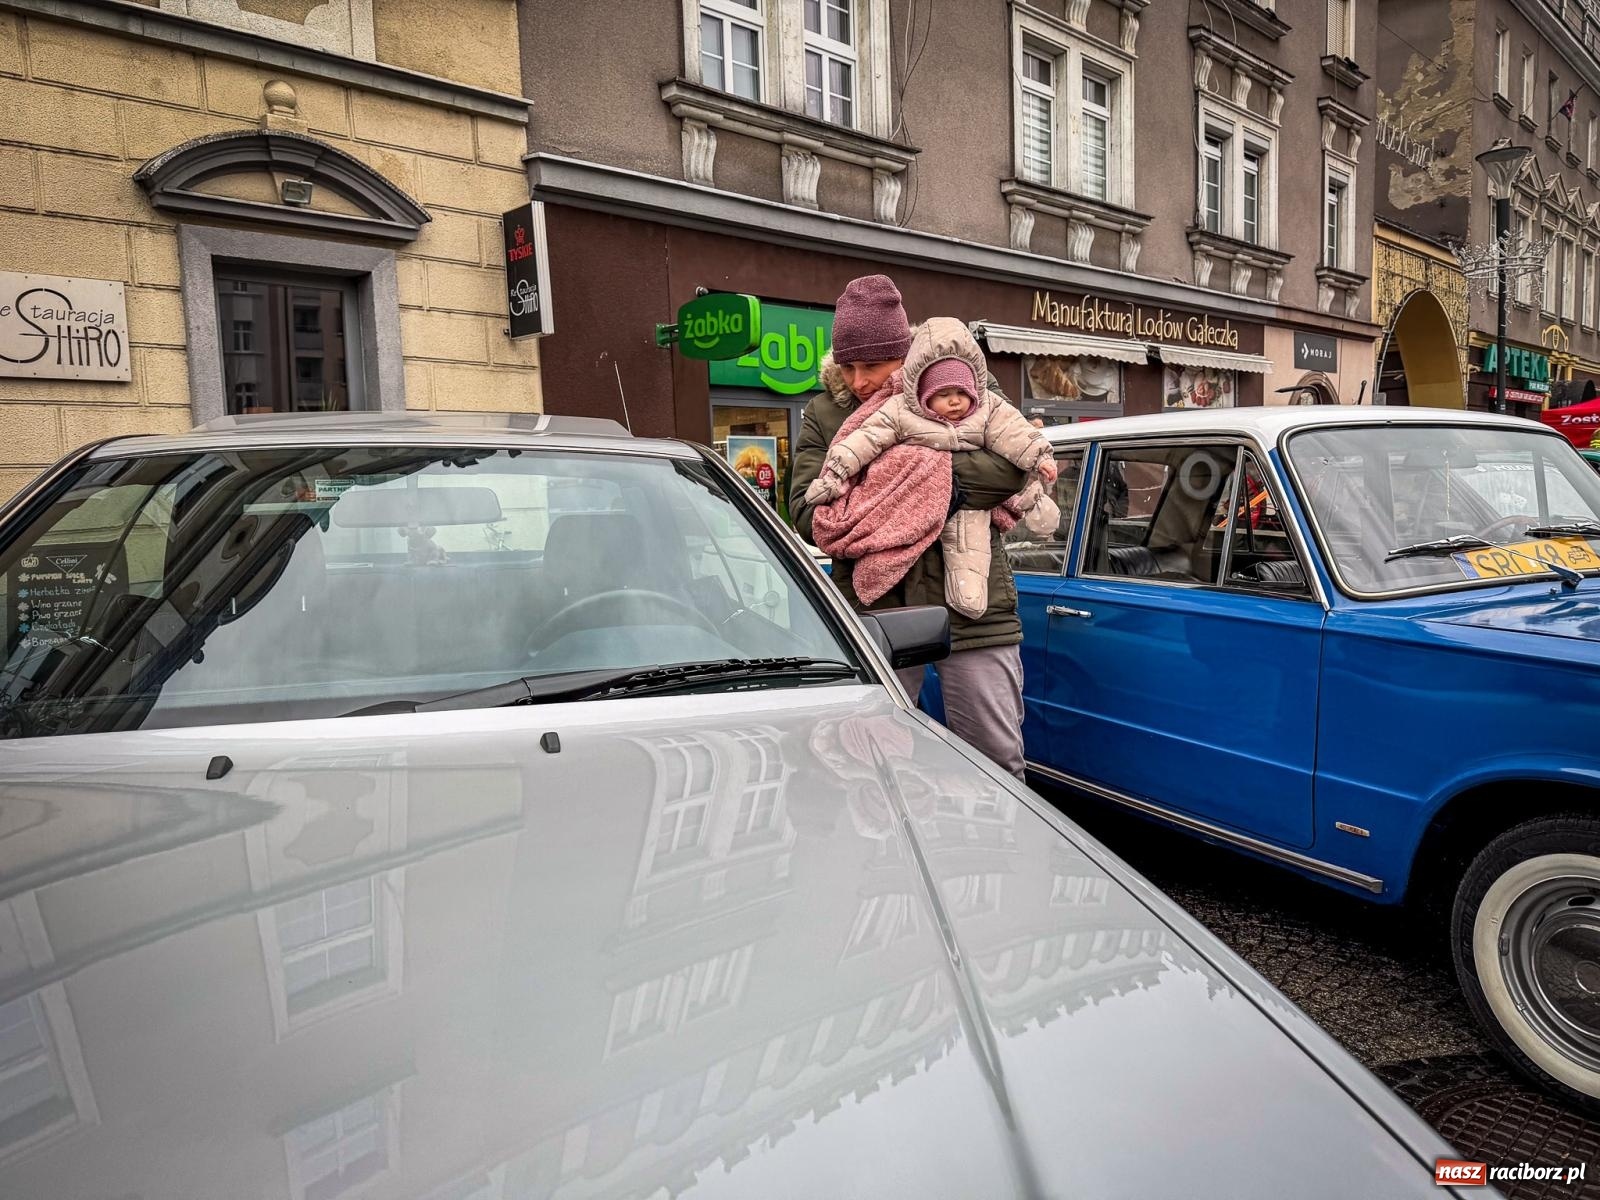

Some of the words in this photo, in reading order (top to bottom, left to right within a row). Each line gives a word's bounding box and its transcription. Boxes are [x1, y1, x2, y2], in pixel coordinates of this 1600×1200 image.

[508, 242, 533, 262] TYSKIE
[684, 309, 743, 339] żabka
[1031, 290, 1133, 336] Manufaktura
[1136, 308, 1184, 341] Lodów
[1187, 313, 1239, 350] Gałeczka
[1560, 413, 1600, 426] Zost
[30, 586, 71, 597] Herbatka
